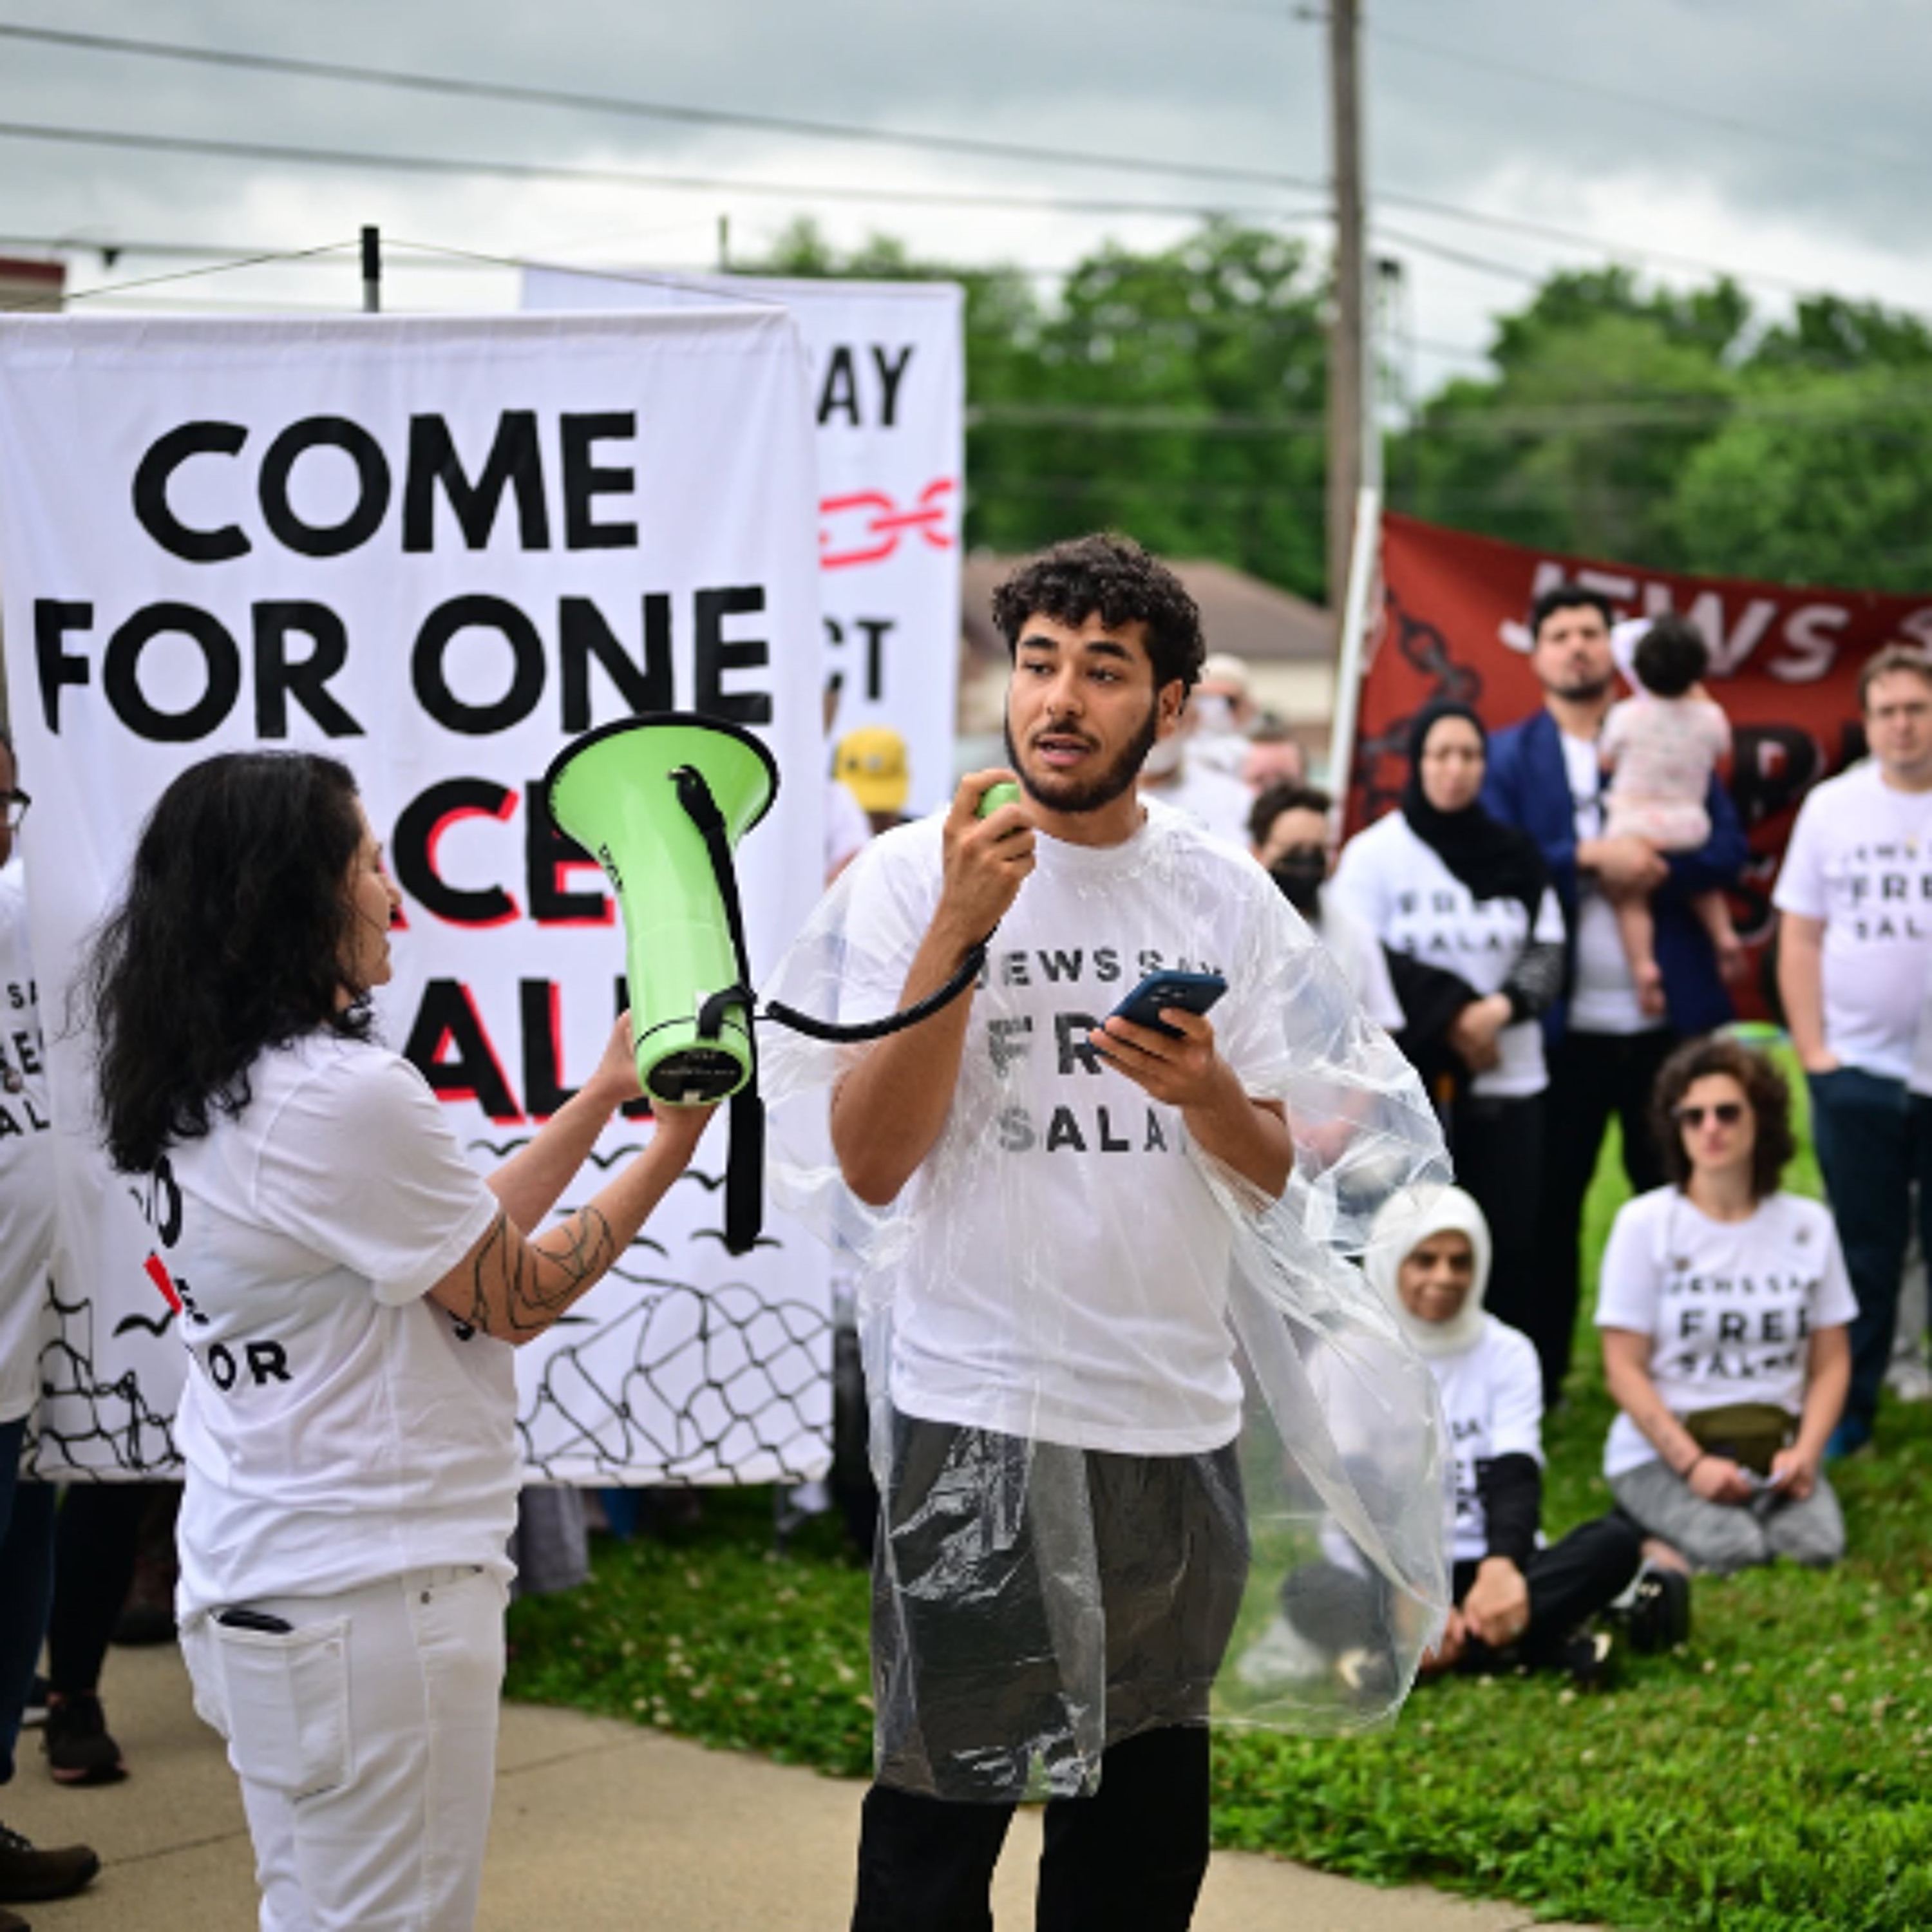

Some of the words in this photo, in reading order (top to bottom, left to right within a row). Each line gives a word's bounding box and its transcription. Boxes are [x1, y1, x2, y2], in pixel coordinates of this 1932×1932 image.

[132, 409, 639, 564] COME
[34, 598, 366, 743] FOR
[411, 585, 773, 736] ONE
[386, 776, 614, 929] CE
[999, 1106, 1188, 1153] SALA
[207, 1340, 292, 1390] OR
